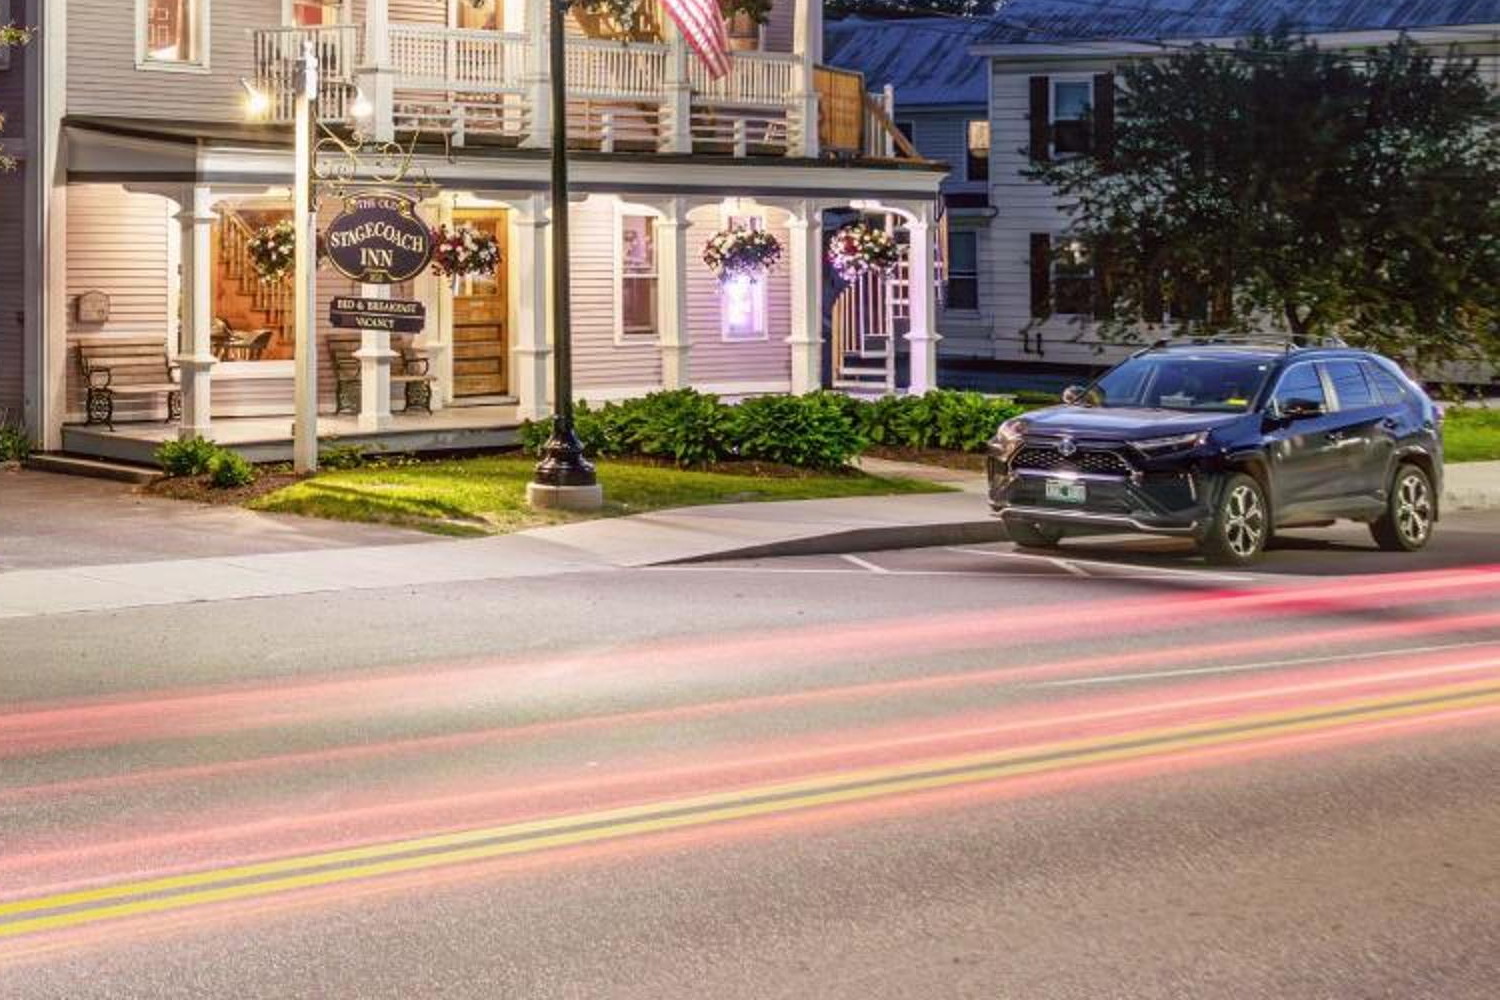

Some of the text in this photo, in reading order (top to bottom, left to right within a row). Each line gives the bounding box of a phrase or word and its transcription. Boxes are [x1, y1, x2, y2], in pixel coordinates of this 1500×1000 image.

[330, 221, 423, 253] STAGECOACH
[360, 247, 393, 267] INN
[337, 299, 417, 313] BED & BREAKFAST
[355, 316, 395, 329] VACANCY
